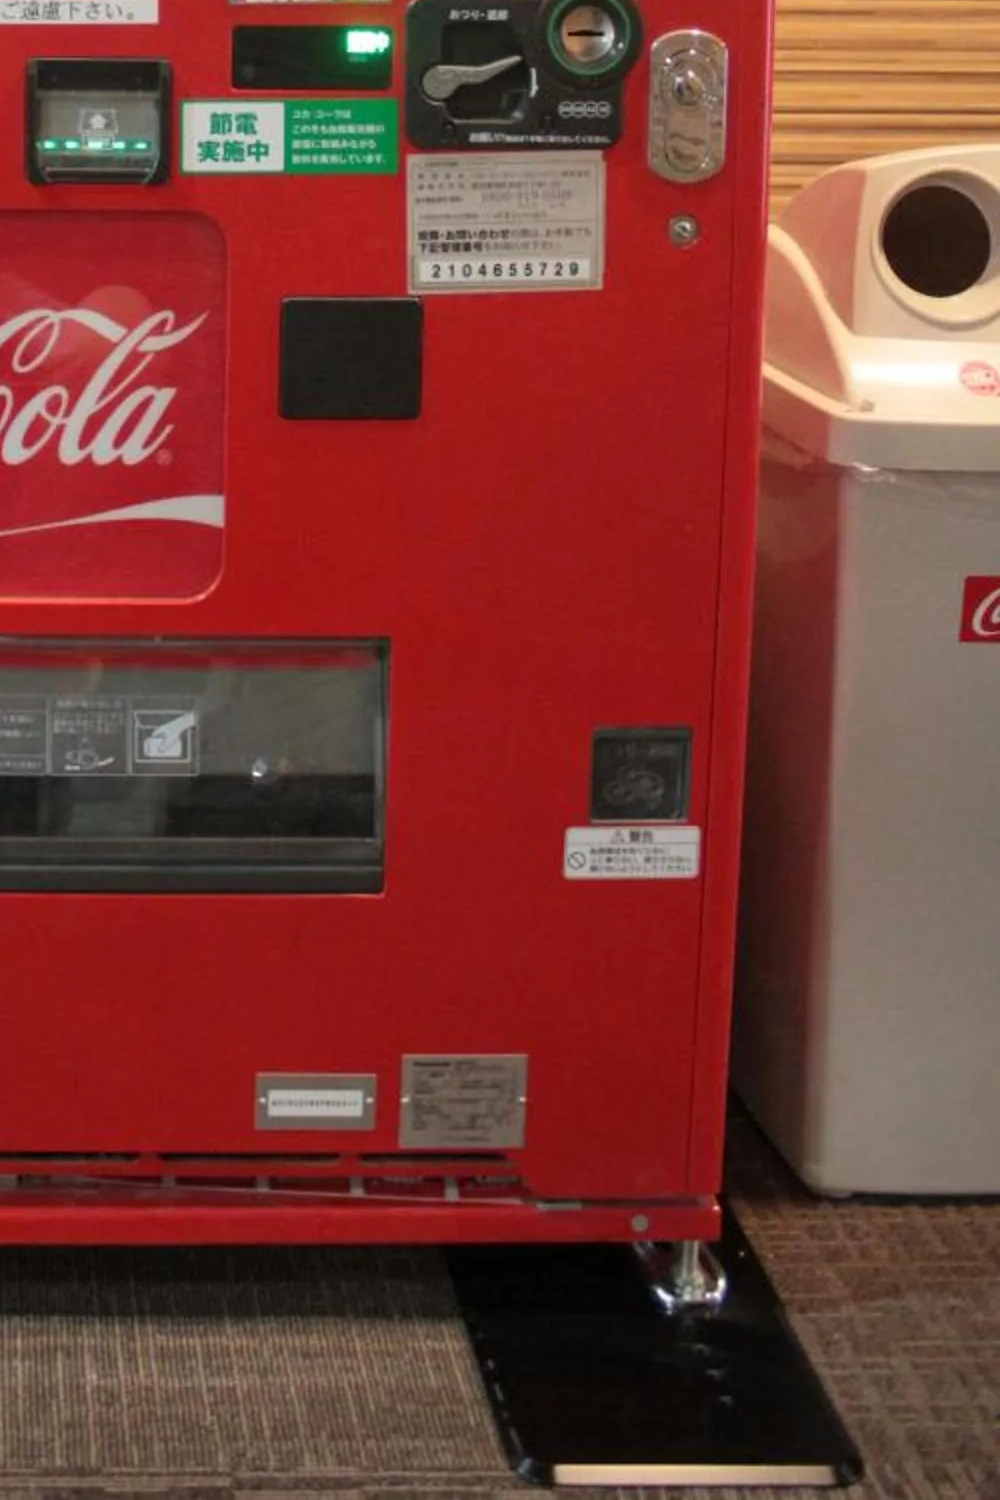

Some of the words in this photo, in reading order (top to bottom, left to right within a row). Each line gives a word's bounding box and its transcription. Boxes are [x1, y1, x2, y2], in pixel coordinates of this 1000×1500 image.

[210, 112, 259, 135] 節電
[196, 140, 270, 162] 実施中
